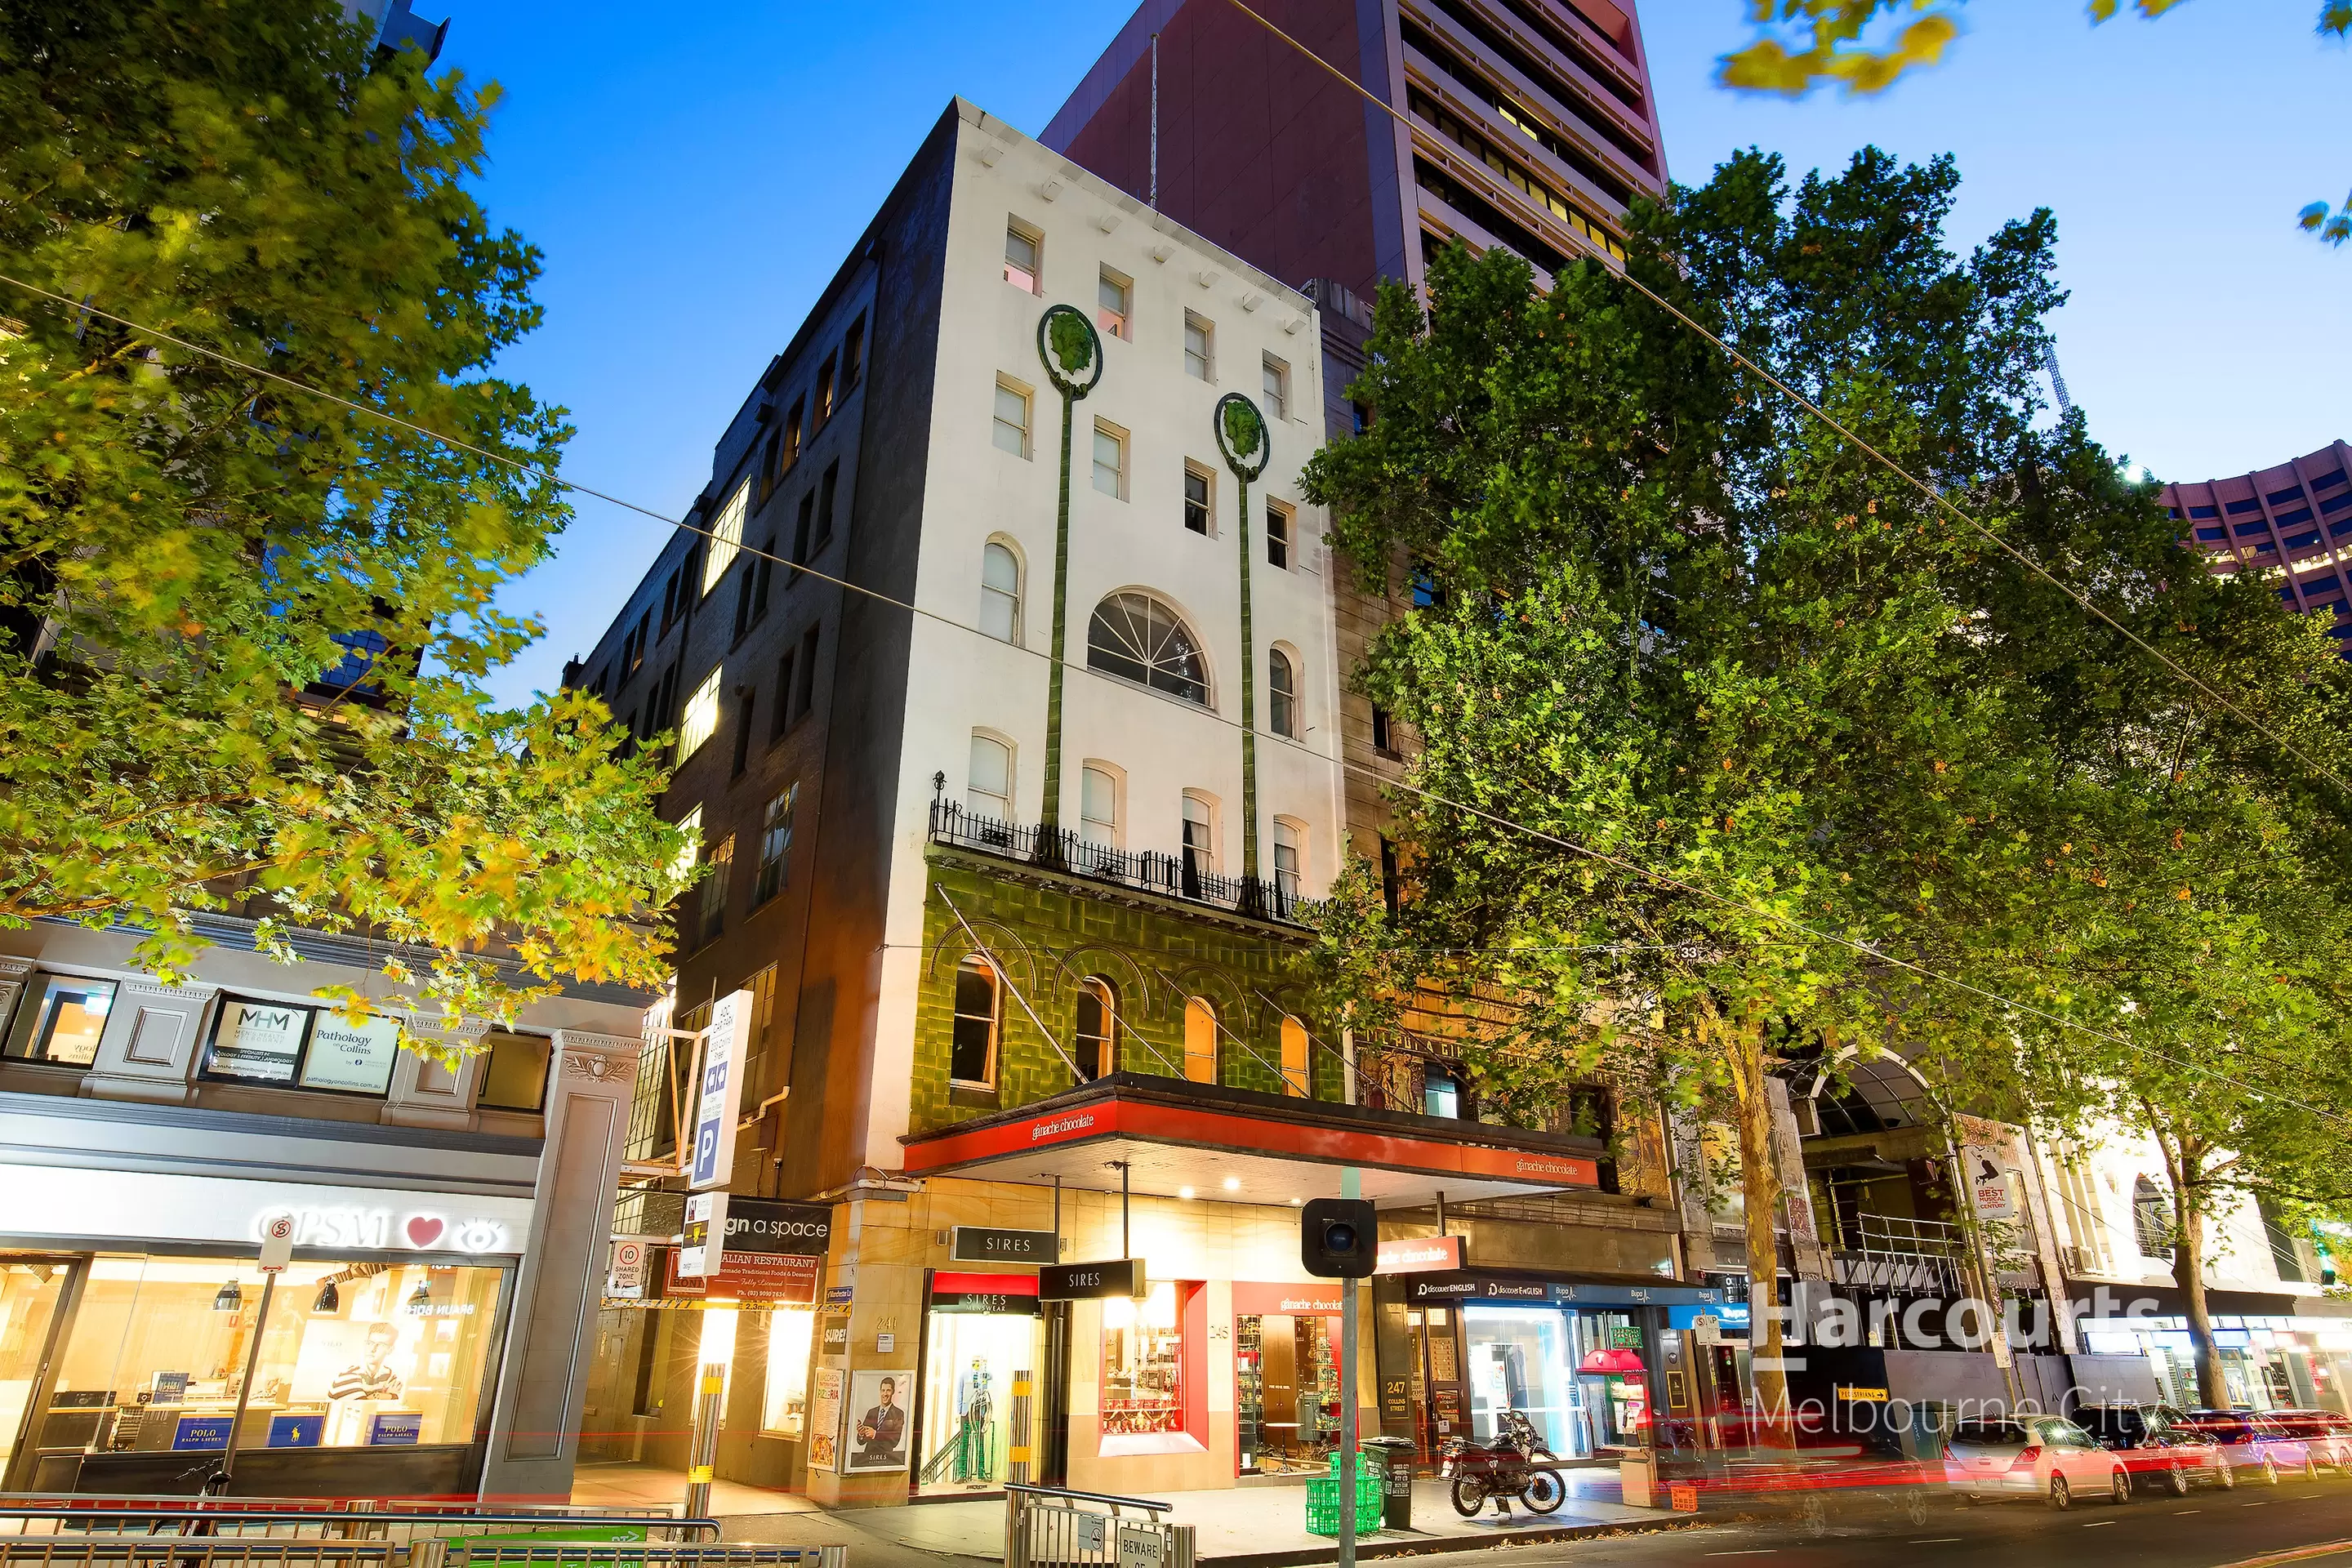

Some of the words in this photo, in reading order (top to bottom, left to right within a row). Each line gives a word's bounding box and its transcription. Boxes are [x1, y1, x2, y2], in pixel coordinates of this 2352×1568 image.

[1681, 947, 1697, 958] 33
[238, 1008, 290, 1031] MHM
[316, 1029, 372, 1047] Pathology
[340, 1044, 372, 1055] Collins
[305, 1076, 381, 1089] pathologyoncollins.com.au
[1060, 1114, 1094, 1132] chocolate
[698, 1129, 714, 1173] P
[1545, 1161, 1578, 1176] chocolate
[1977, 1189, 2005, 1197] BEST
[753, 1219, 766, 1234] a
[770, 1219, 828, 1239] space
[986, 1236, 1031, 1252] SIRES
[625, 1250, 635, 1259] 10
[722, 1254, 751, 1264] ALIAN
[753, 1256, 816, 1268] RESTAURANT
[741, 1278, 757, 1288] Fully
[757, 1279, 784, 1287] Licensed
[1068, 1272, 1101, 1288] SIRES
[1556, 1286, 1569, 1295] Bupa
[1631, 1290, 1643, 1298] Bupa
[1698, 1291, 1710, 1299] Bupa
[966, 1294, 1007, 1306] SIRES
[1312, 1298, 1343, 1311] chocolat
[1723, 1307, 1748, 1319] Bupa
[824, 1329, 847, 1343] SURE!
[1387, 1381, 1405, 1394] 247
[1841, 1391, 1875, 1399] PEDESTRIANS
[190, 1428, 216, 1437] POLO
[385, 1425, 408, 1433] POLO
[1123, 1539, 1157, 1559] BEWARE
